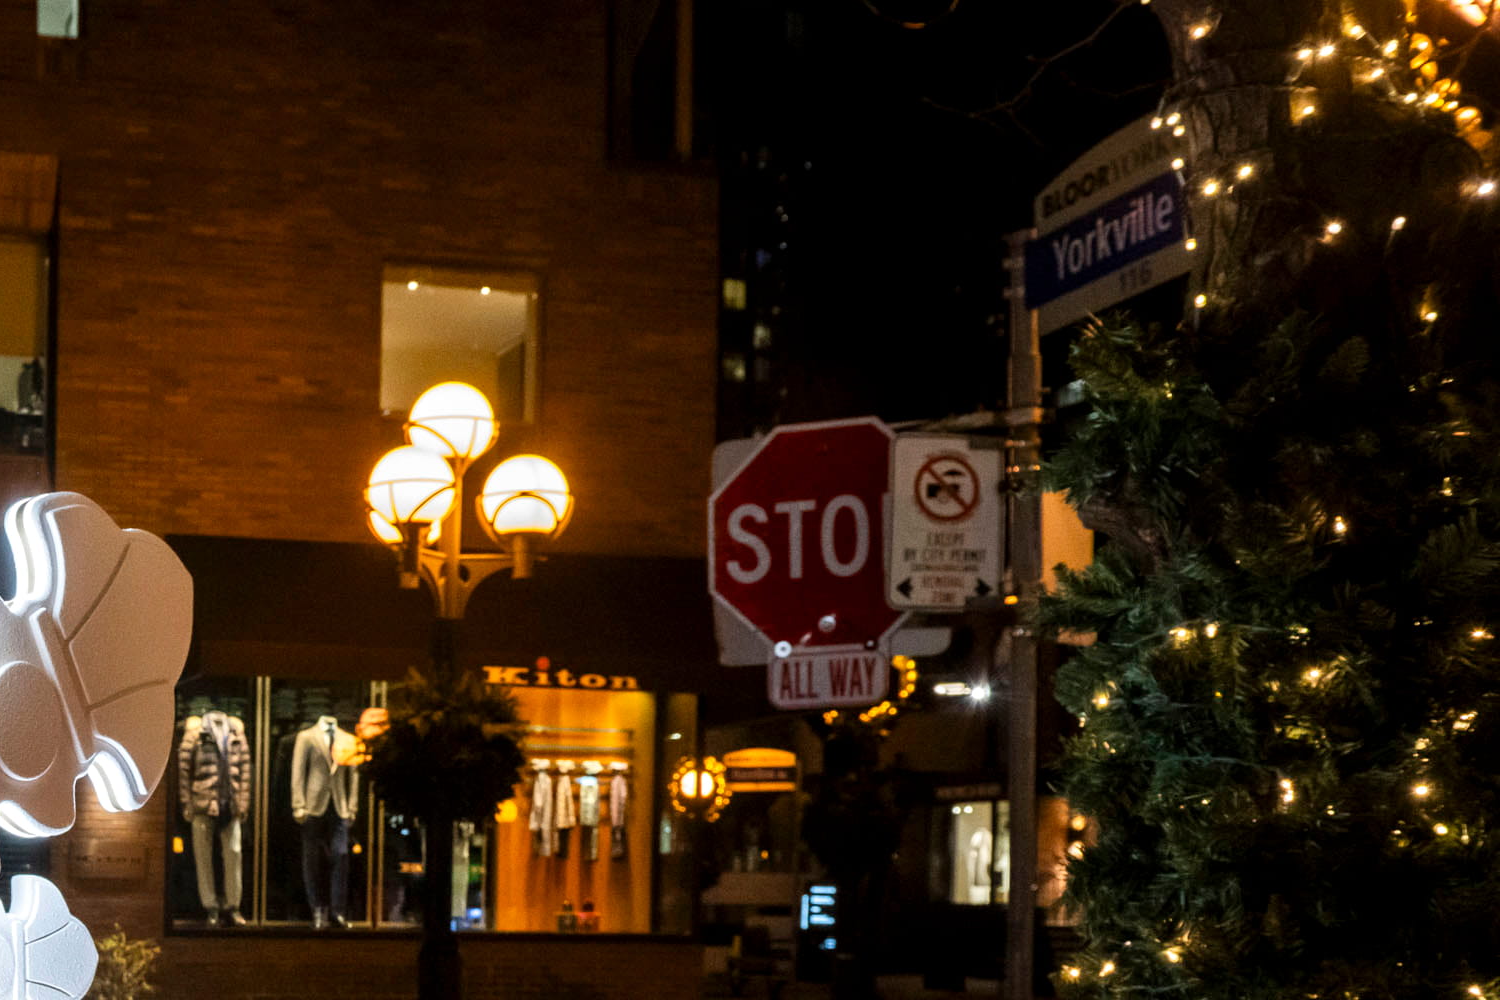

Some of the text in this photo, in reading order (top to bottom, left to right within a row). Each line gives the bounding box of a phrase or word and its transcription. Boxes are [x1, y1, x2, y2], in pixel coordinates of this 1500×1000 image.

[1052, 191, 1174, 281] Yorkville
[725, 494, 870, 584] STO
[482, 656, 639, 691] Kiton
[779, 656, 878, 700] ALL WAY
